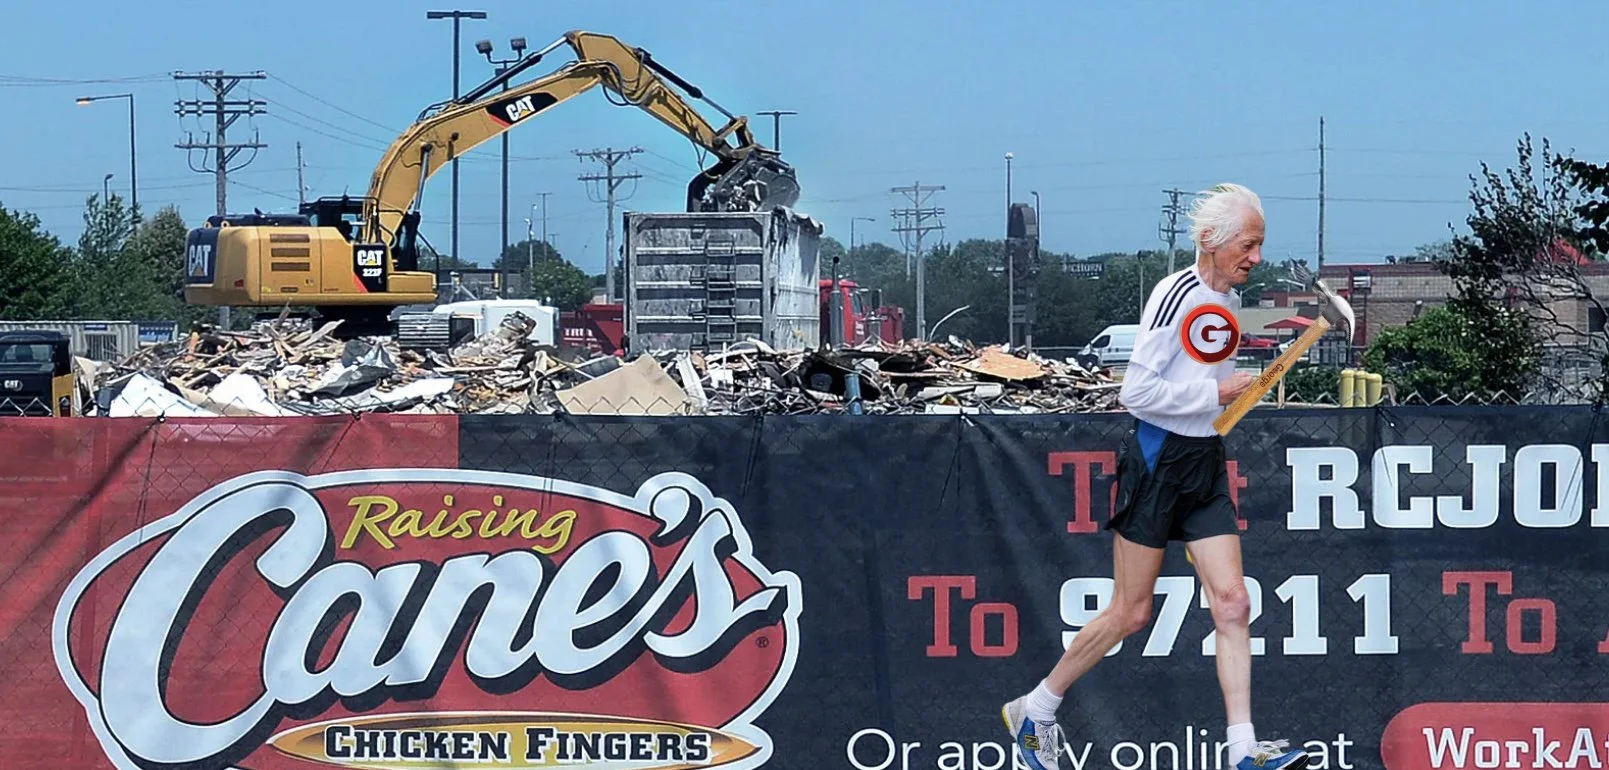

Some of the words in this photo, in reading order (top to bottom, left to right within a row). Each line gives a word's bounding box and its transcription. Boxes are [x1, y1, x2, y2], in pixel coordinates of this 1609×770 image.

[505, 95, 536, 121] CAT
[188, 244, 212, 277] CAT
[357, 250, 384, 266] CAT
[1189, 313, 1232, 354] G
[4, 380, 20, 389] CAT
[1260, 363, 1285, 388] George
[1048, 451, 1248, 533] Tt
[340, 495, 577, 553] Raising
[99, 482, 780, 764] Cane's
[908, 575, 1018, 657] To
[1442, 571, 1556, 654] To
[325, 724, 511, 760] CHICKEN
[525, 724, 711, 763] FINGERS
[846, 728, 920, 770] Or
[937, 740, 1093, 770] apy
[1303, 732, 1354, 770] at
[1422, 727, 1609, 769] WorkA
